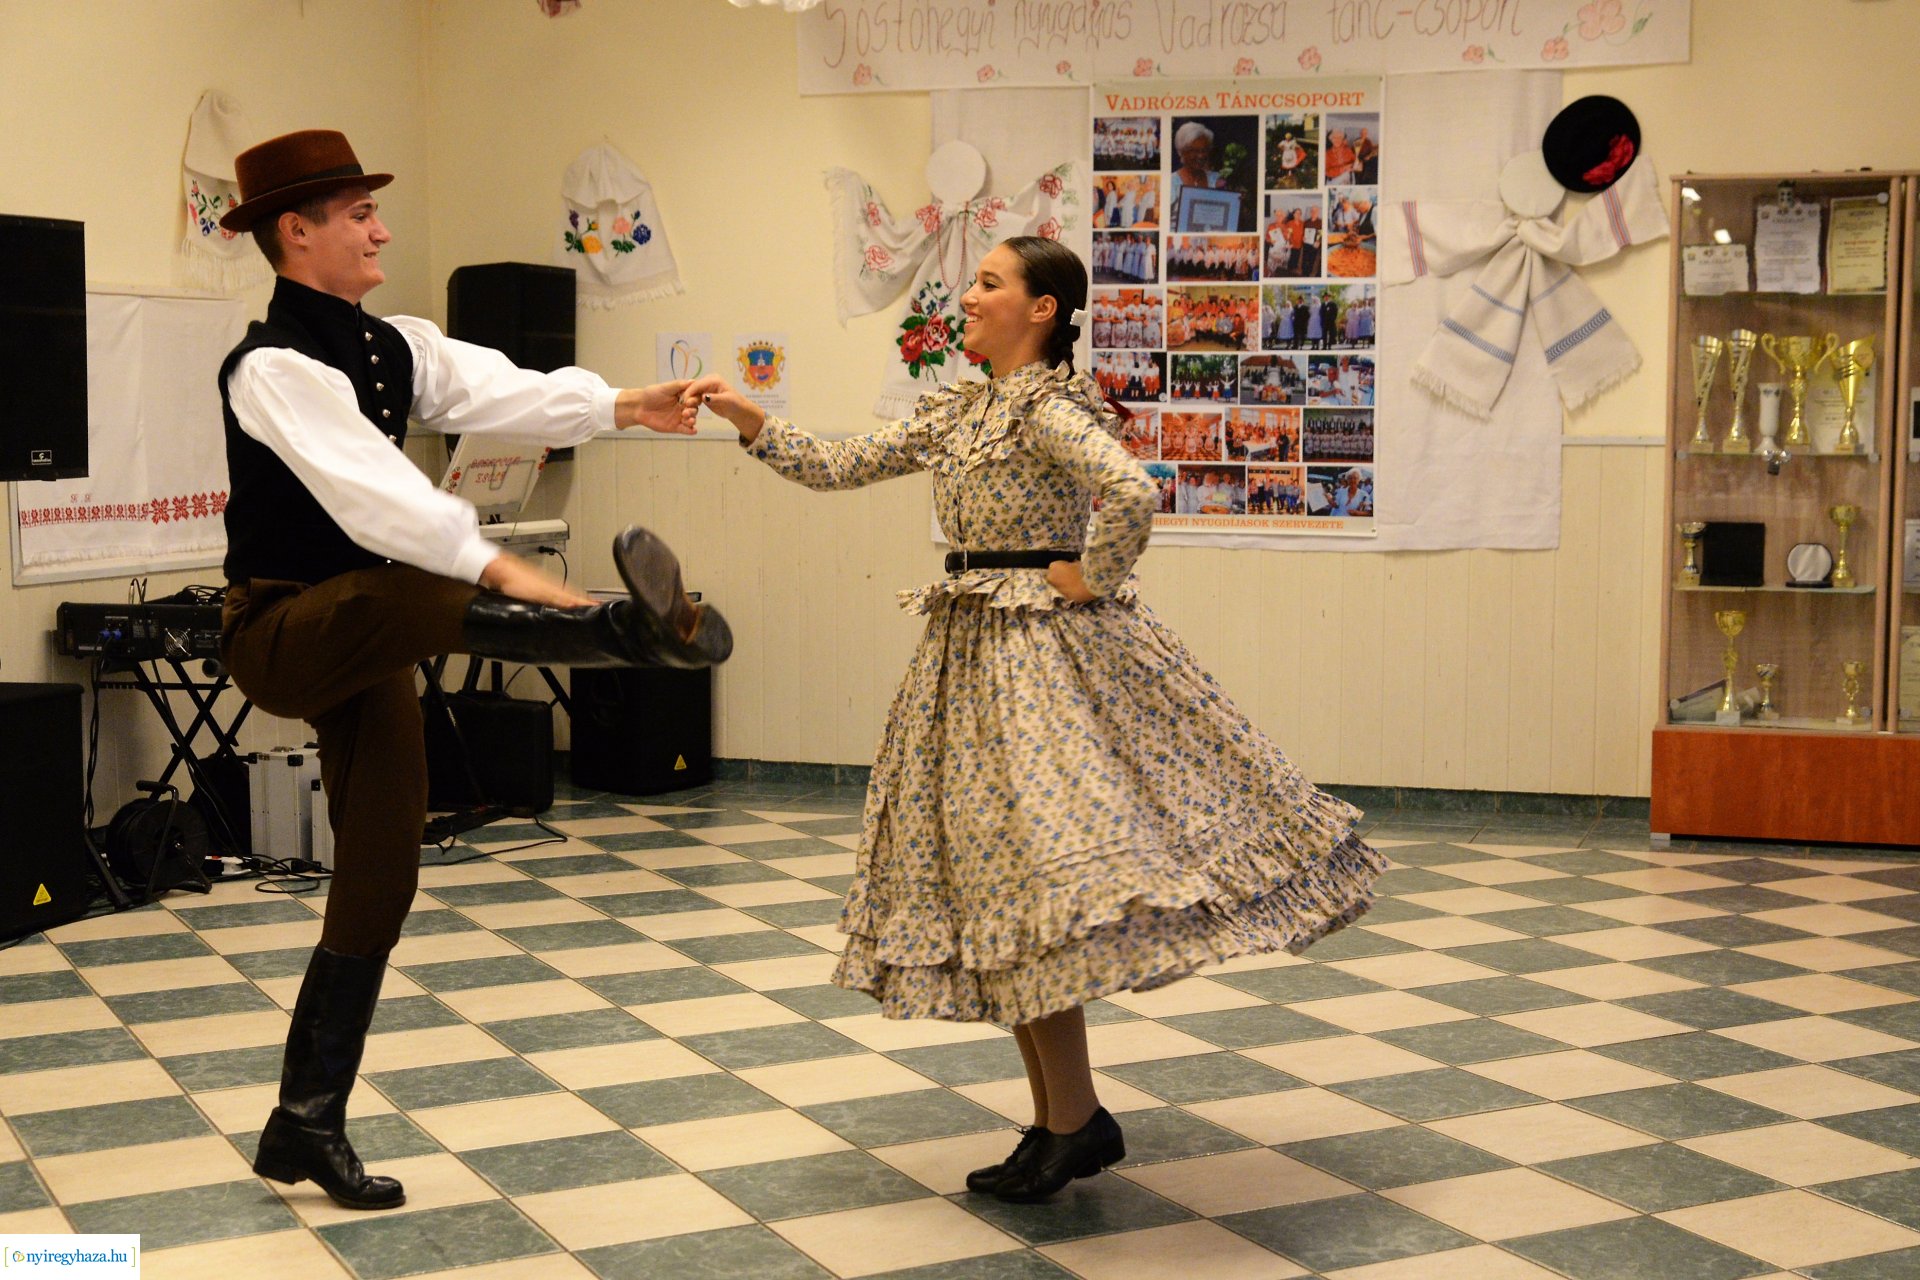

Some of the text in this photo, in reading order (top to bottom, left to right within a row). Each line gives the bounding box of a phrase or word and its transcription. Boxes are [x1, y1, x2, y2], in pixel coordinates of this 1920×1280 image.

[1105, 89, 1365, 111] VADRÓZSA TÁNCCSOPORT
[1152, 516, 1189, 527] HEGYI
[1272, 518, 1345, 530] SZERVEZETE
